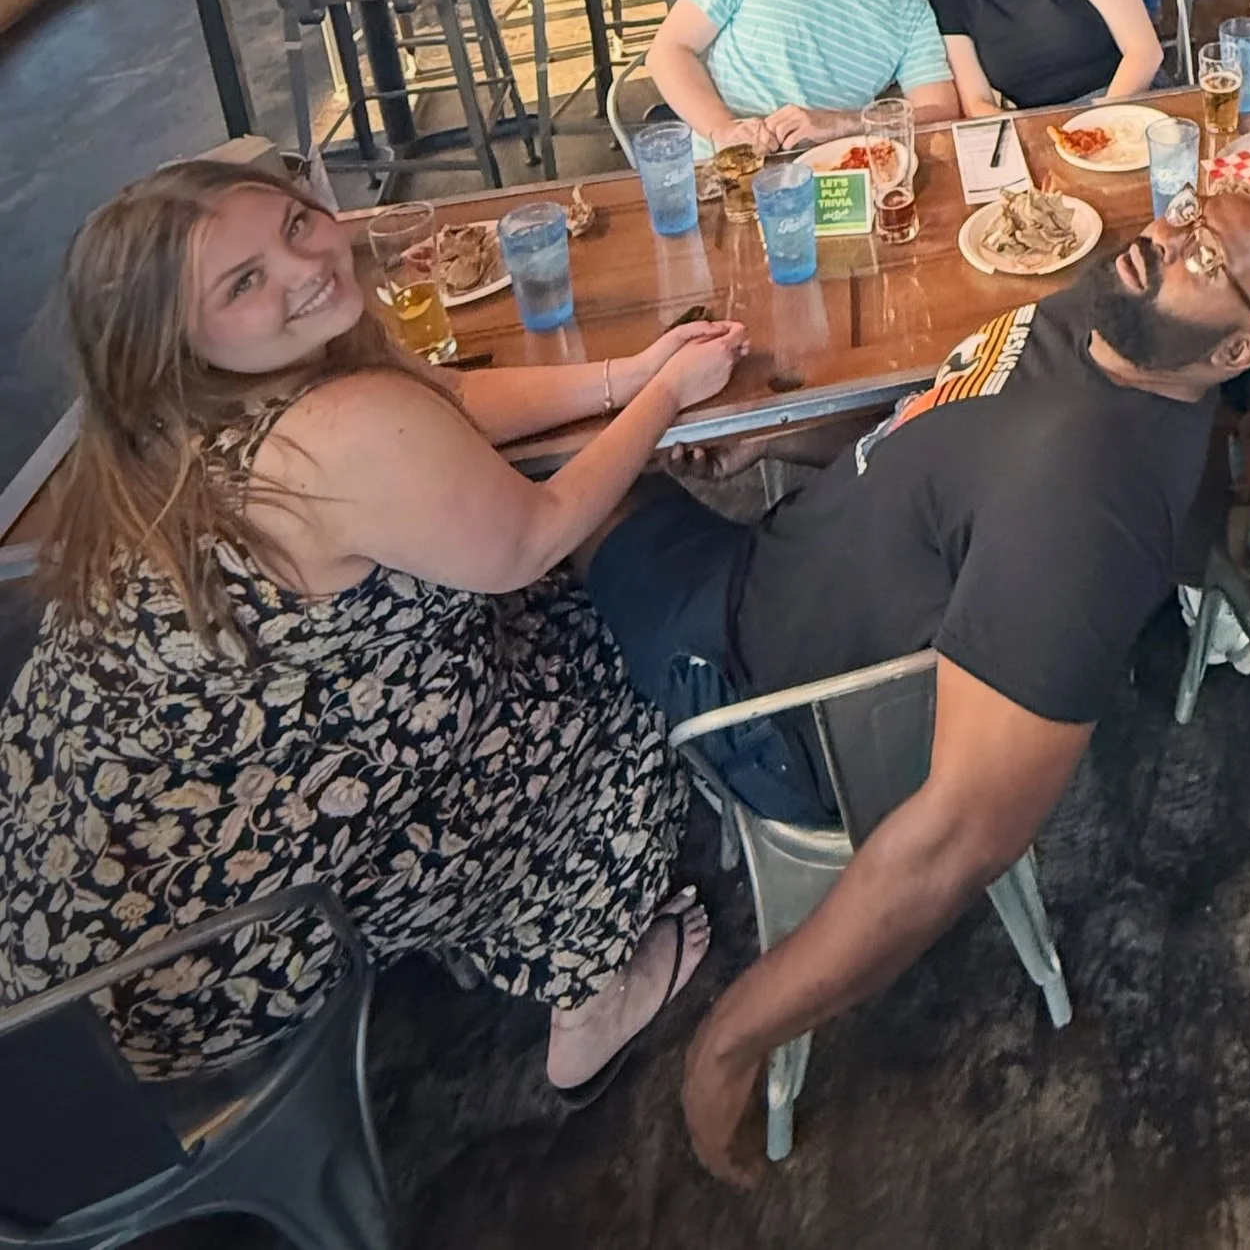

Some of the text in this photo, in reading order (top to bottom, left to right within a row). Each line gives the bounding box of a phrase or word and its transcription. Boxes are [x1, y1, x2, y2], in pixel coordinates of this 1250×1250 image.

[820, 178, 849, 188] LET'S
[821, 187, 849, 198] PLAY
[818, 197, 853, 208] TRIVIA
[992, 324, 1031, 372] JESUS
